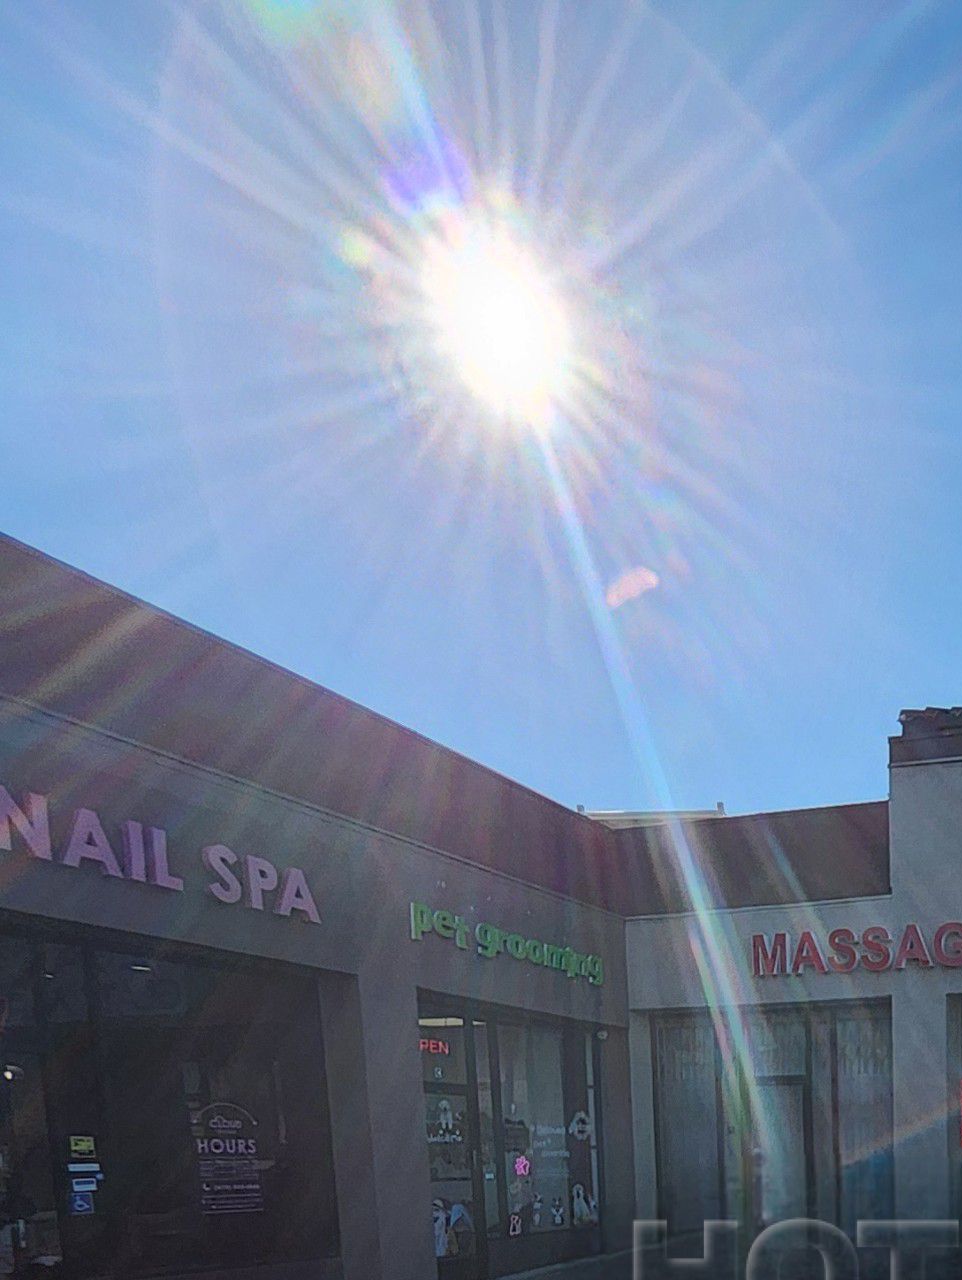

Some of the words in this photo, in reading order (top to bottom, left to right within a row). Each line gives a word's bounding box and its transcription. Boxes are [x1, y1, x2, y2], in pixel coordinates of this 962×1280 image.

[0, 784, 184, 892] NAIL
[202, 843, 322, 925] SPA
[410, 900, 469, 950] pet
[475, 921, 605, 987] grooming
[418, 1038, 449, 1055] PEN
[196, 1138, 257, 1154] HOURS
